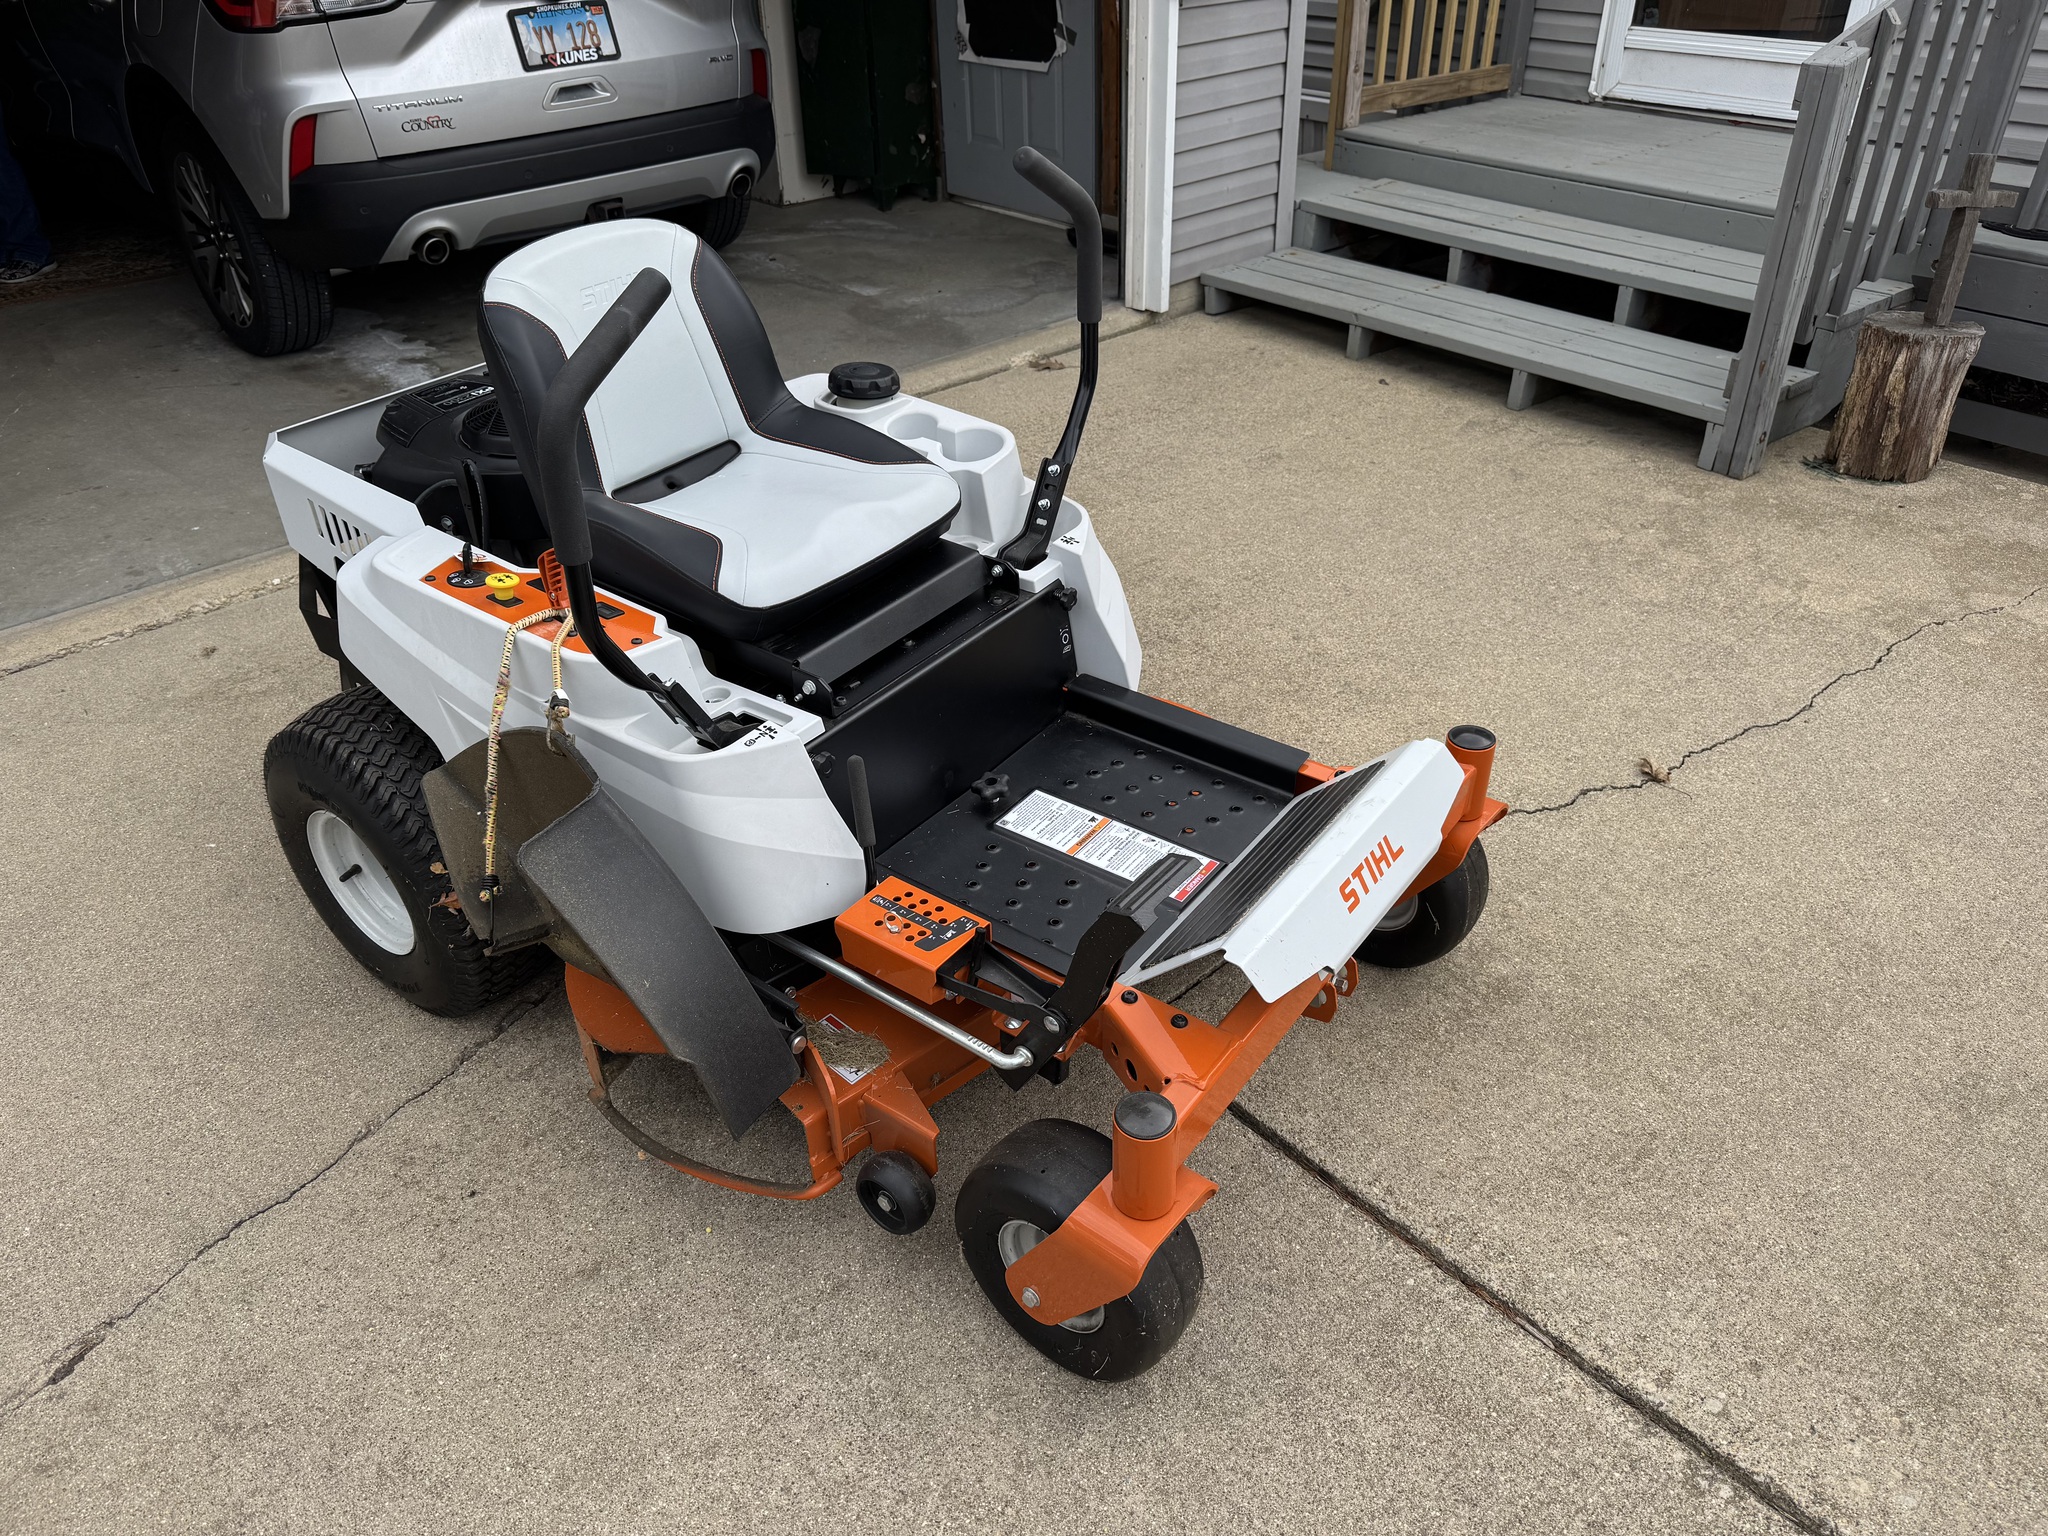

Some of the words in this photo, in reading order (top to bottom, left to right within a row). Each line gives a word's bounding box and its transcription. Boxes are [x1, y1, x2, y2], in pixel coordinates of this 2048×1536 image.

[536, 2, 582, 13] SHOPKUNES.COM
[566, 19, 602, 51] 128
[556, 48, 599, 65] KUNES
[372, 95, 464, 112] TITANIUM
[401, 117, 456, 133] COUNTRY
[1339, 834, 1405, 914] STIHL
